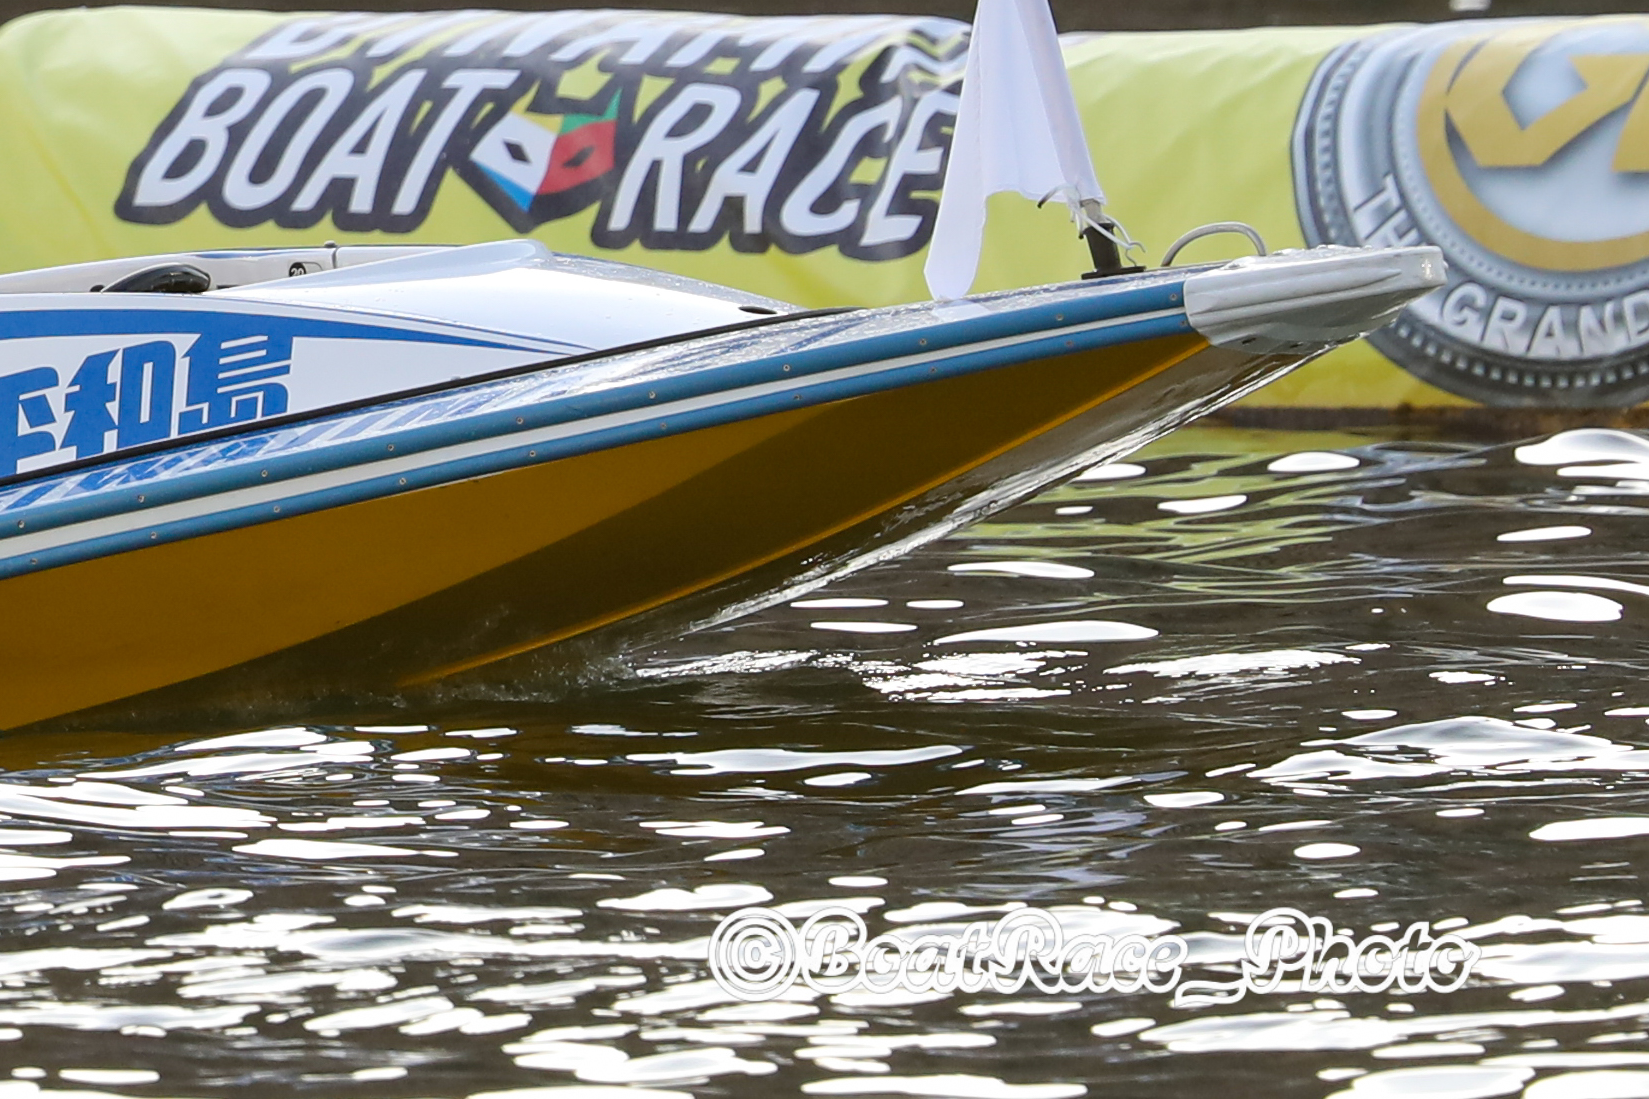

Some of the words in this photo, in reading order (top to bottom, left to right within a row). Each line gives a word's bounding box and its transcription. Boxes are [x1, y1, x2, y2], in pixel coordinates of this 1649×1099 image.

[134, 67, 521, 215] BOAT
[607, 82, 964, 246] RACE
[1353, 172, 1421, 248] TH
[1441, 281, 1649, 358] GRAND
